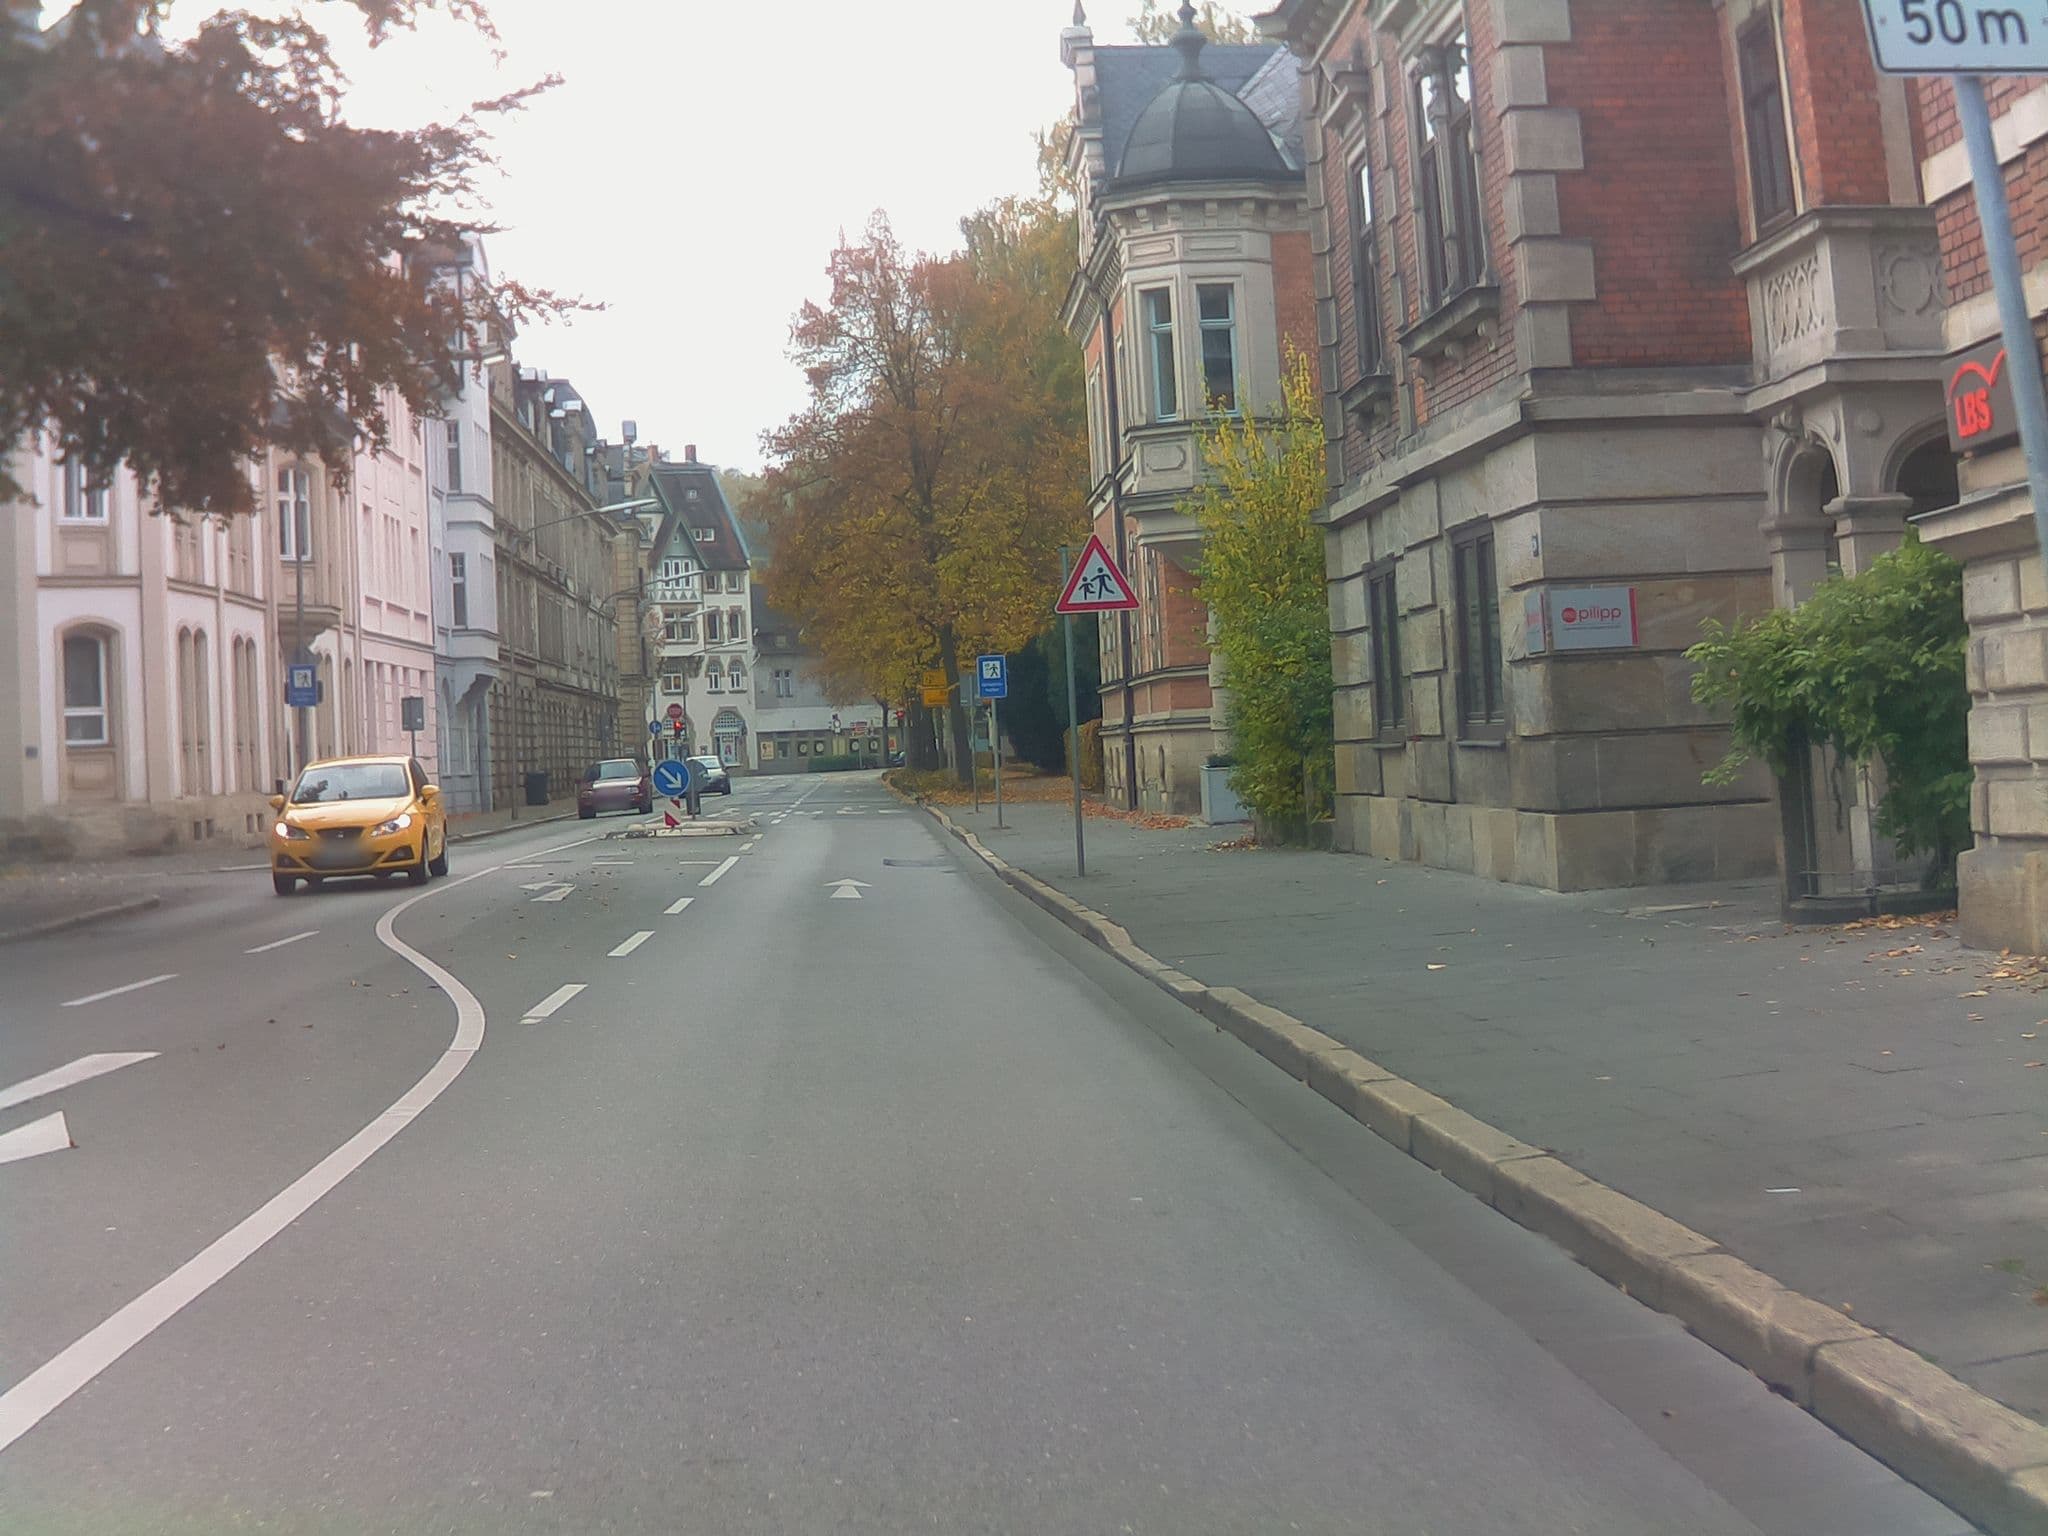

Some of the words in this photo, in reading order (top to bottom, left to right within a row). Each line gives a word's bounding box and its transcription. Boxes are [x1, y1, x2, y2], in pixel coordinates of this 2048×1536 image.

[1901, 0, 1967, 45] 50
[1976, 8, 2029, 45] m
[1954, 388, 1993, 438] LBS
[1579, 606, 1622, 622] pilipp
